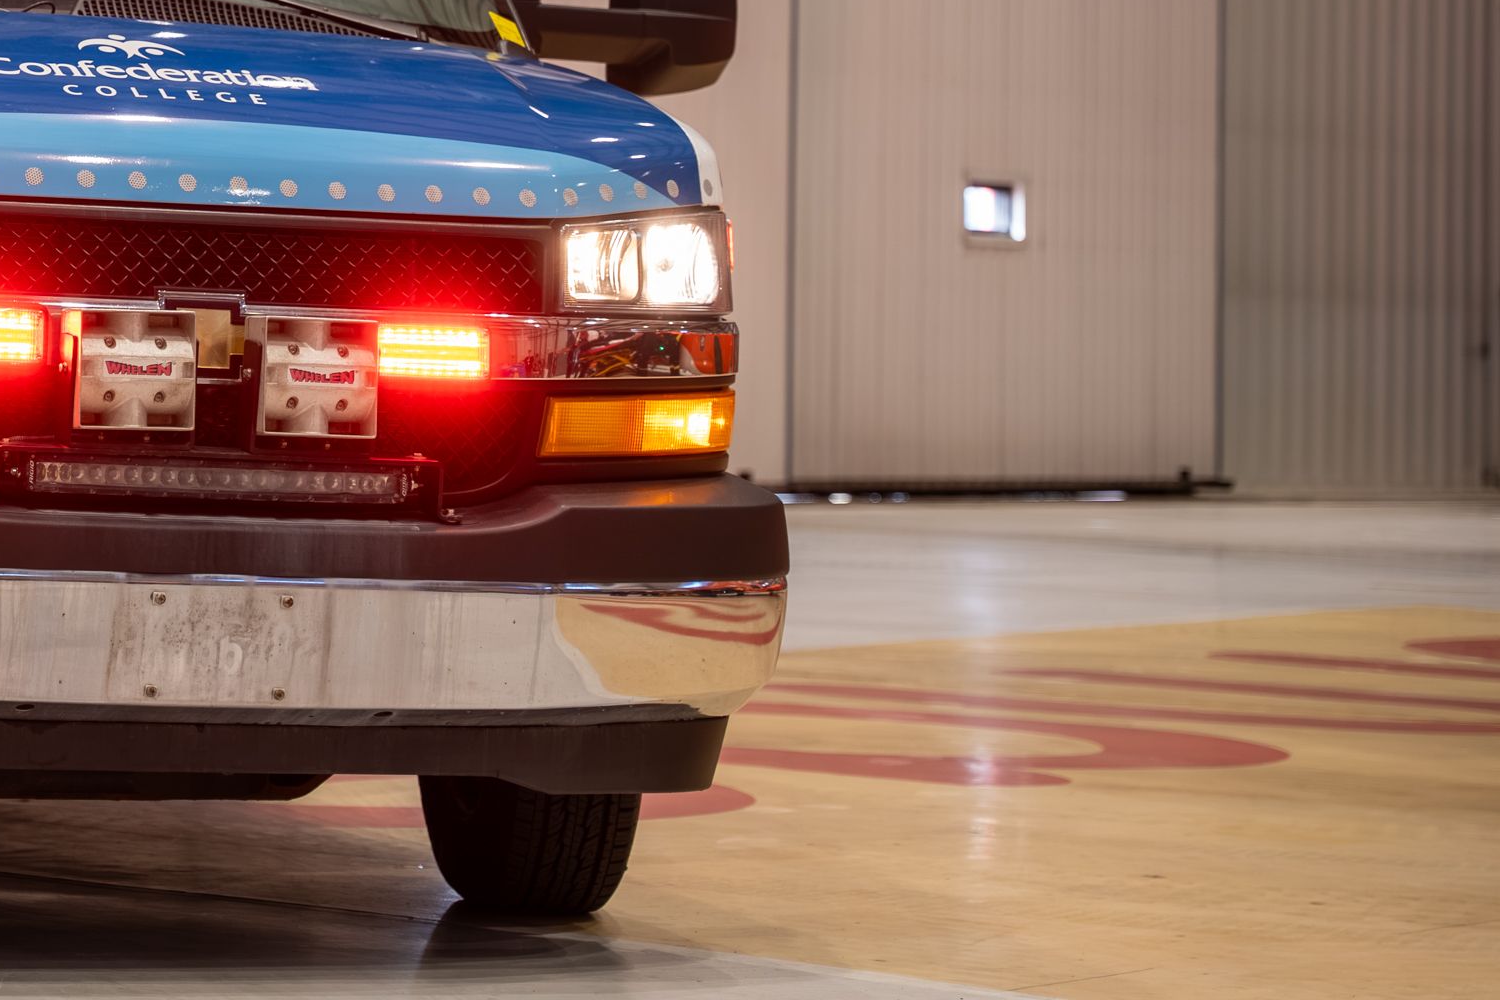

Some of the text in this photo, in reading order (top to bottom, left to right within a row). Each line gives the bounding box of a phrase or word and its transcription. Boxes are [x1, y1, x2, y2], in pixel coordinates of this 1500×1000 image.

[62, 83, 268, 106] COLLEGE
[104, 360, 173, 377] WHELEN
[289, 367, 355, 385] WHELEN
